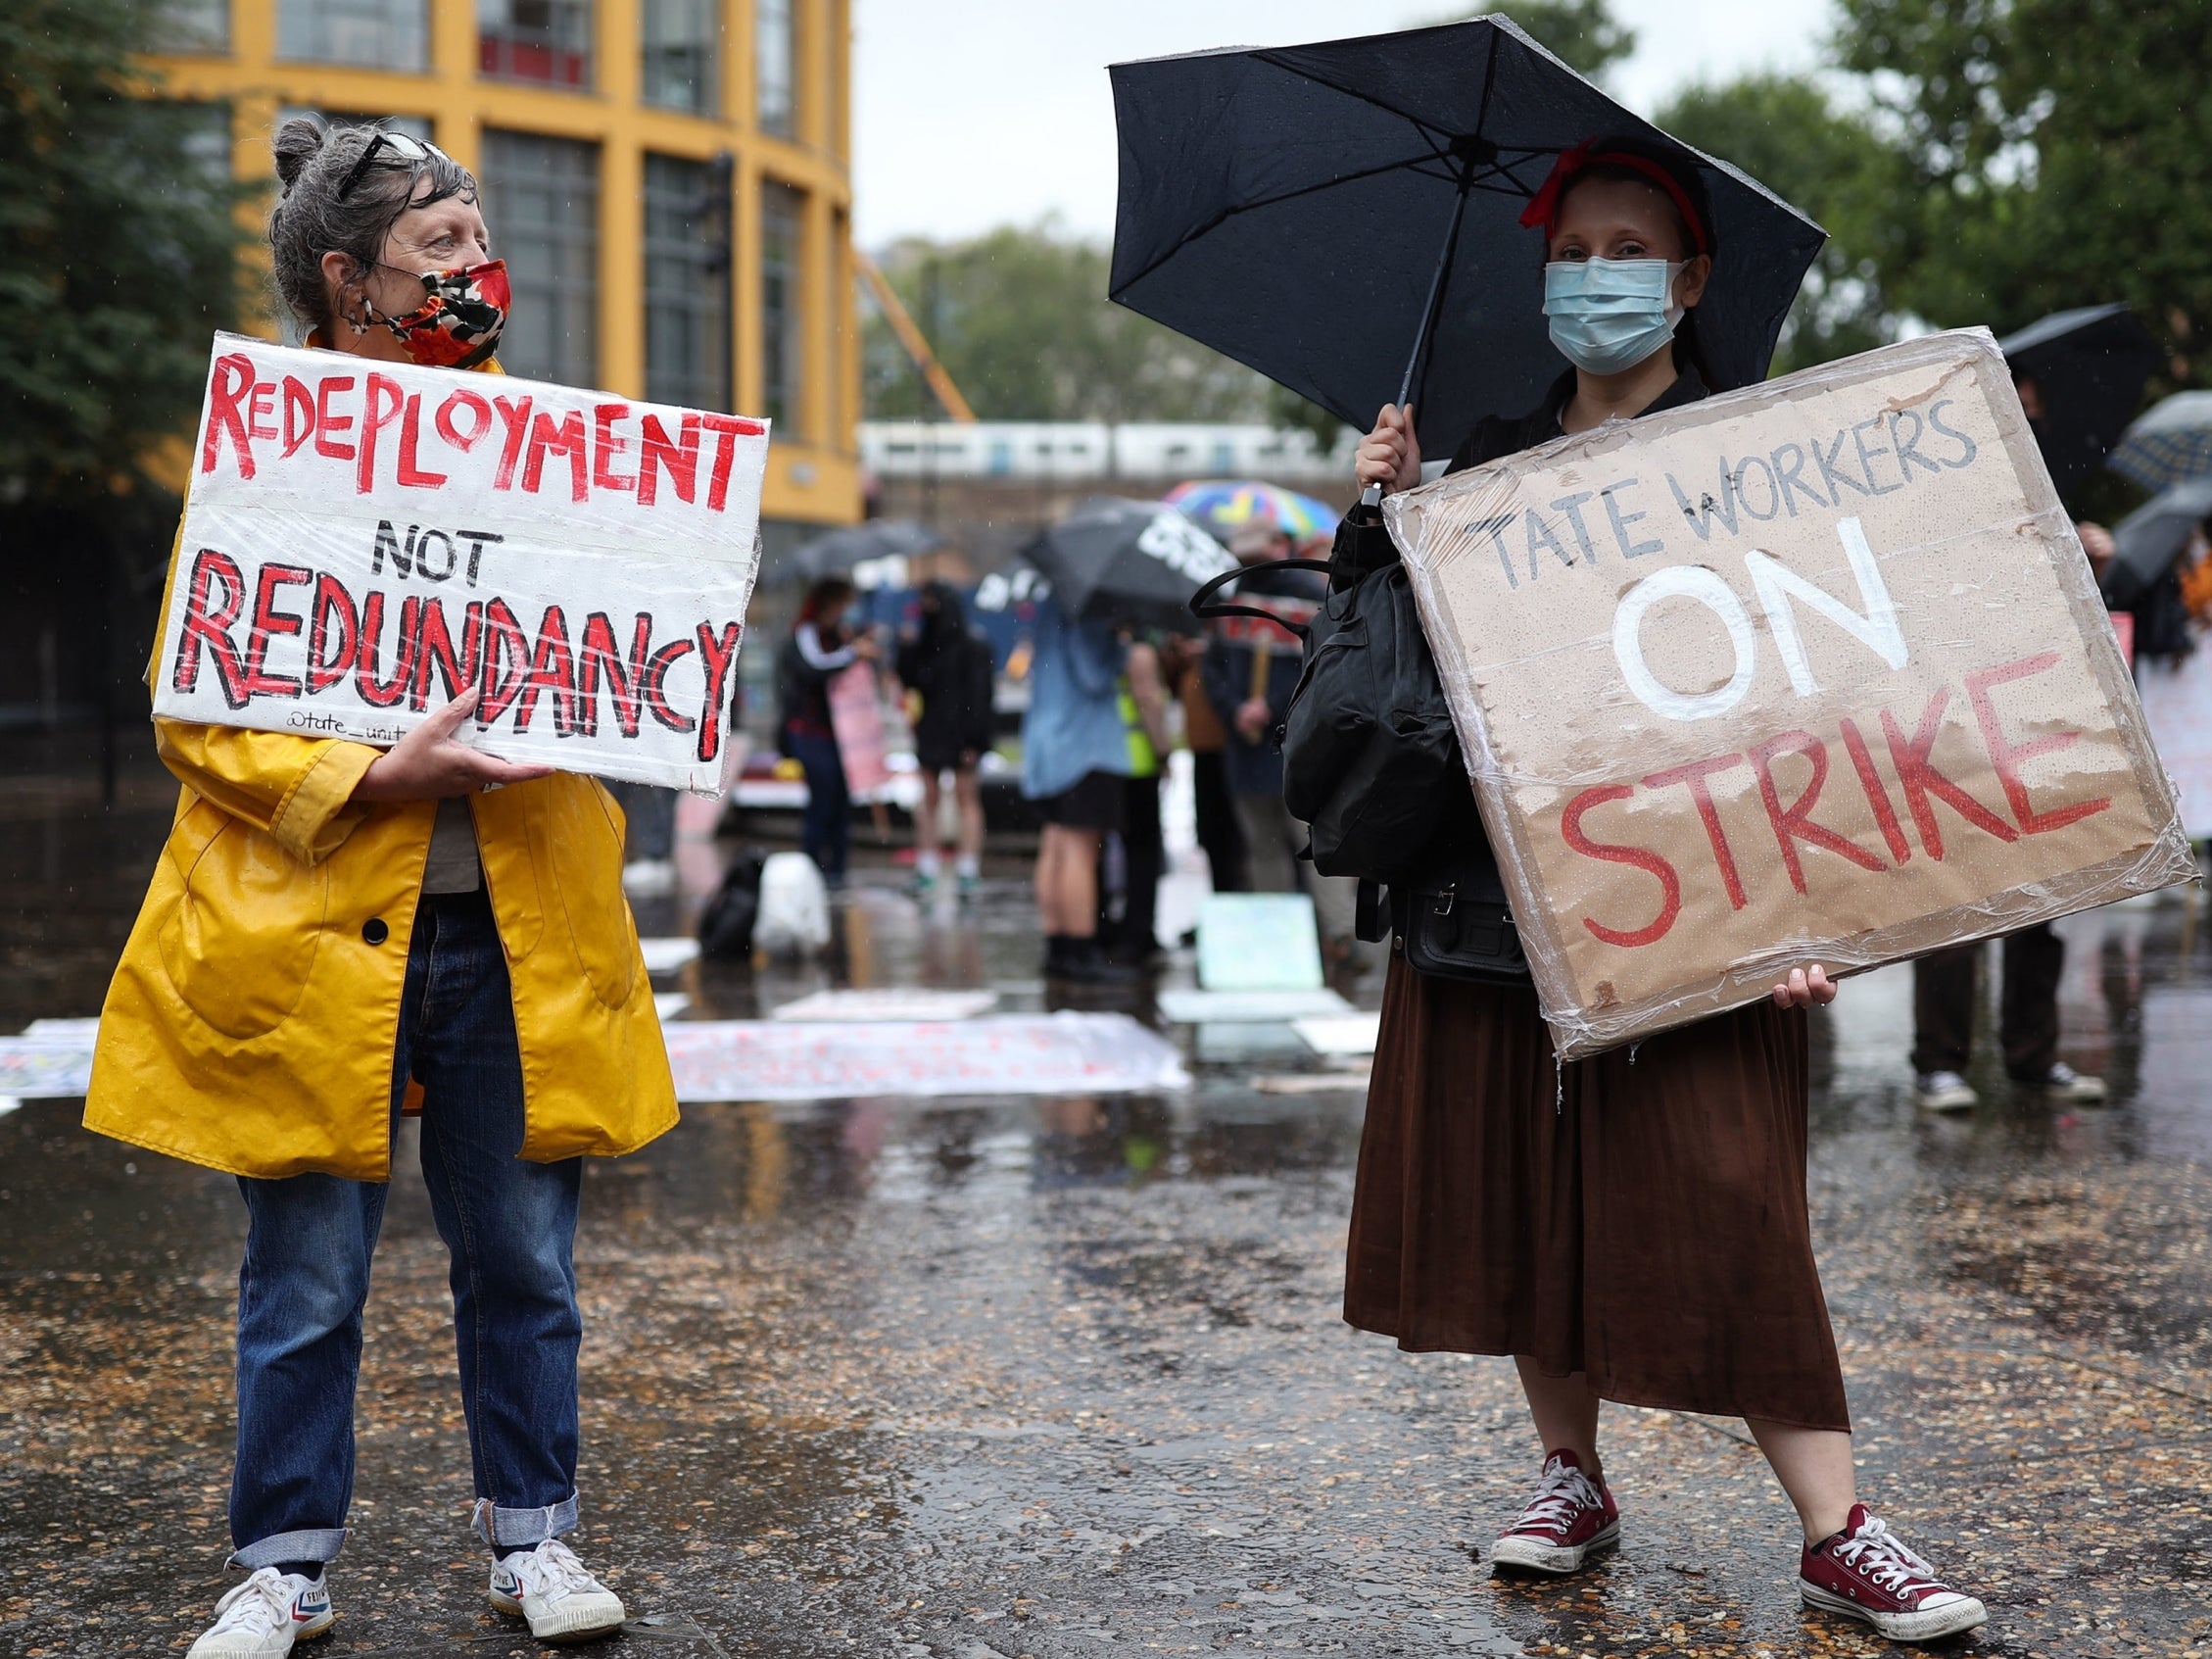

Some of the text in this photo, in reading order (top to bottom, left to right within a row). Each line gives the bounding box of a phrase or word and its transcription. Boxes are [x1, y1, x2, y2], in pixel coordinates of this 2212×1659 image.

[202, 353, 764, 512] REDEPLOYMENT
[1465, 398, 1978, 589] TATE WORKERS
[370, 519, 505, 588] NOT
[1612, 515, 1909, 721] ON
[172, 548, 741, 762] REDUNDANCY
[286, 710, 407, 742] @tate_unit
[1560, 652, 2112, 949] STRIKE
